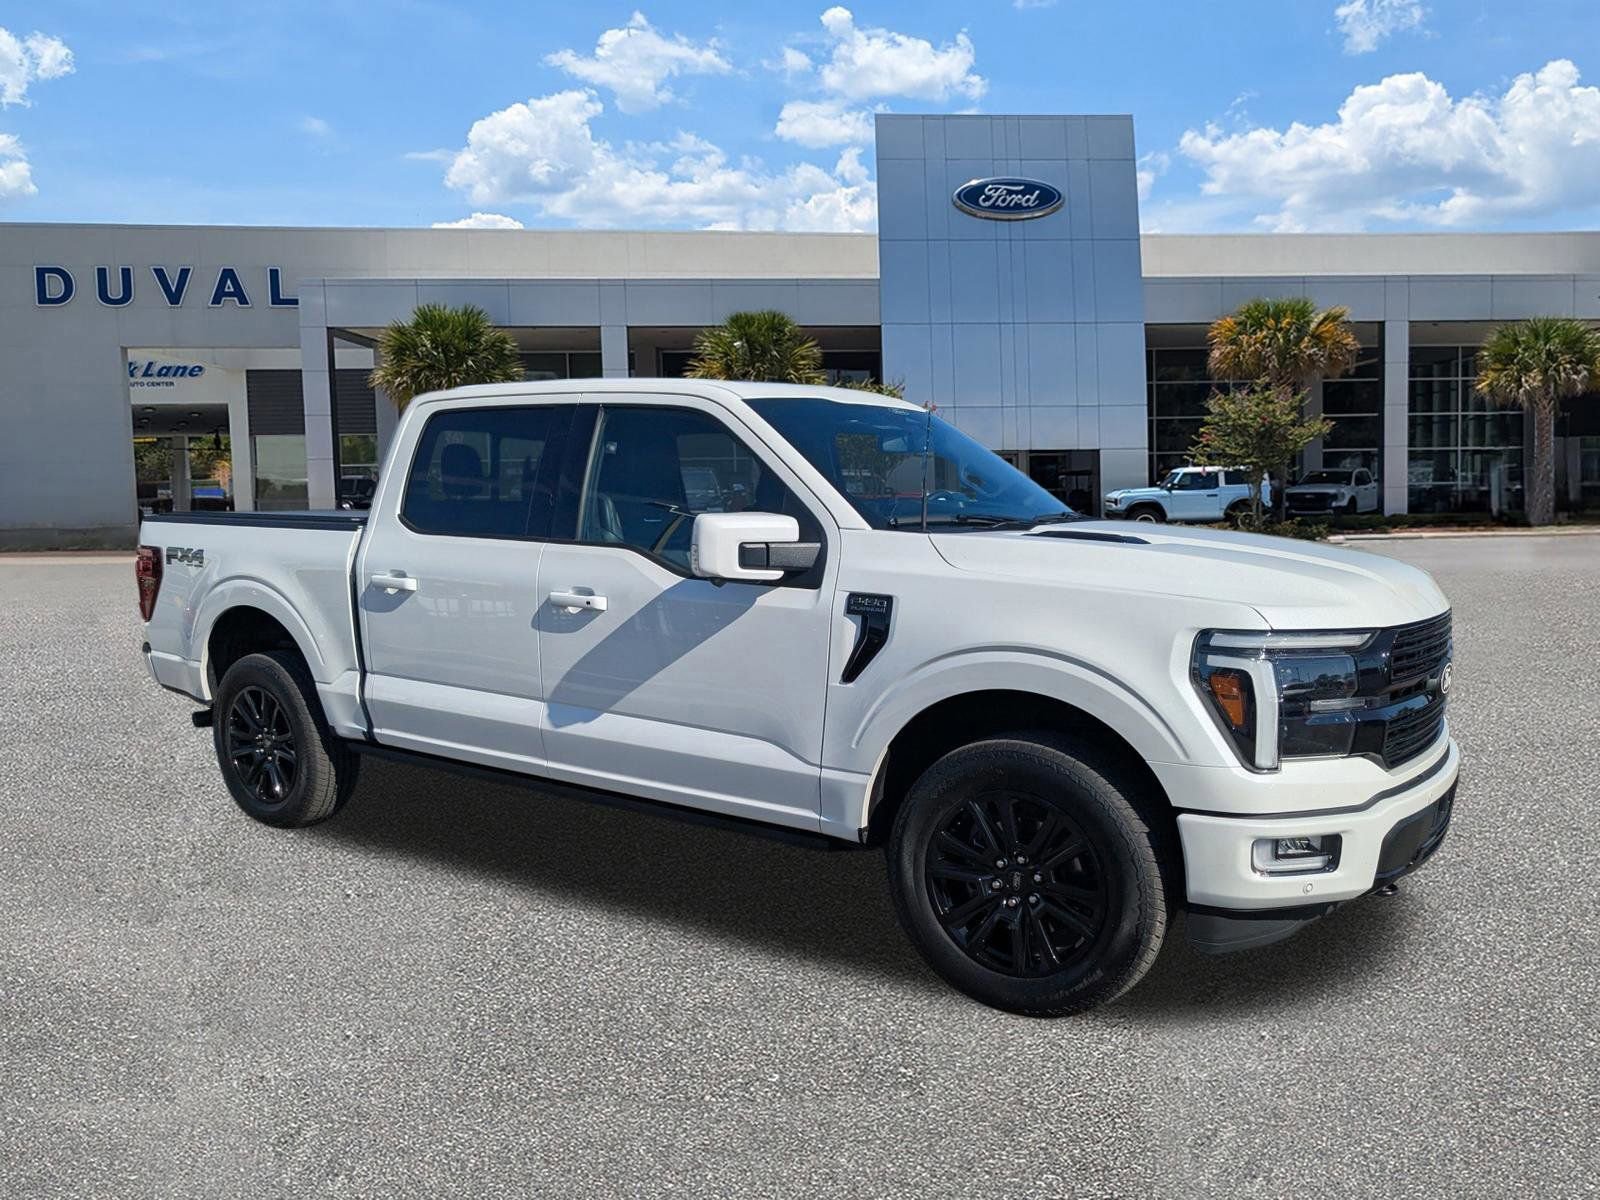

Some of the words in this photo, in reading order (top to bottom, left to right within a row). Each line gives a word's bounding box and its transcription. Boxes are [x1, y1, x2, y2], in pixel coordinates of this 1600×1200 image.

[979, 184, 1040, 208] Ford
[33, 265, 299, 308] DUVAL
[141, 361, 204, 378] Lane
[166, 546, 204, 567] FX4
